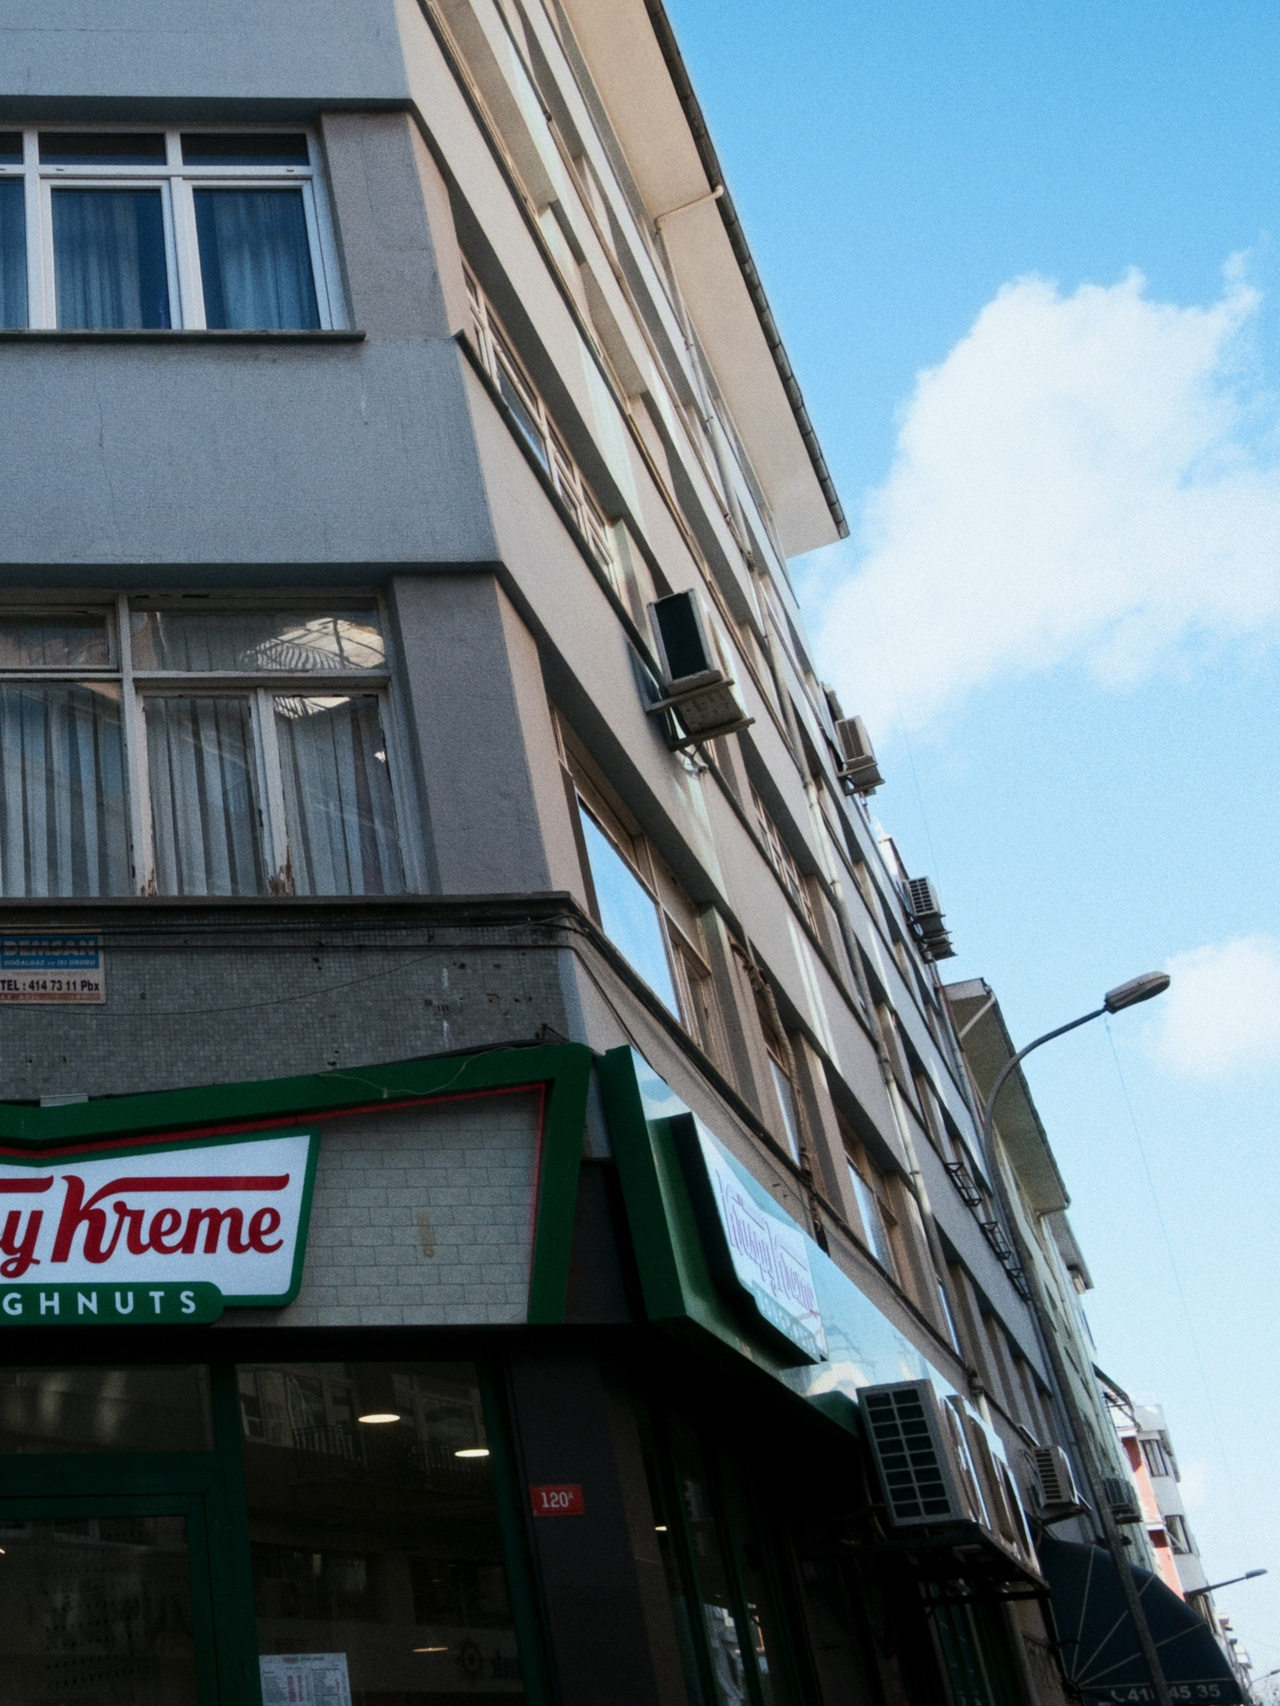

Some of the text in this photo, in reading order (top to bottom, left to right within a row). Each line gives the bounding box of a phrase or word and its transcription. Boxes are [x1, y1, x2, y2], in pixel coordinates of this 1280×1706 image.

[3, 940, 95, 956] DEMSAN
[0, 980, 19, 991] TEL
[28, 980, 47, 991] 414
[50, 980, 63, 991] 73
[66, 980, 77, 991] 11
[80, 980, 100, 991] Pbx
[50, 1174, 290, 1264] Kreme
[1127, 1684, 1221, 1702] 41 45 35
